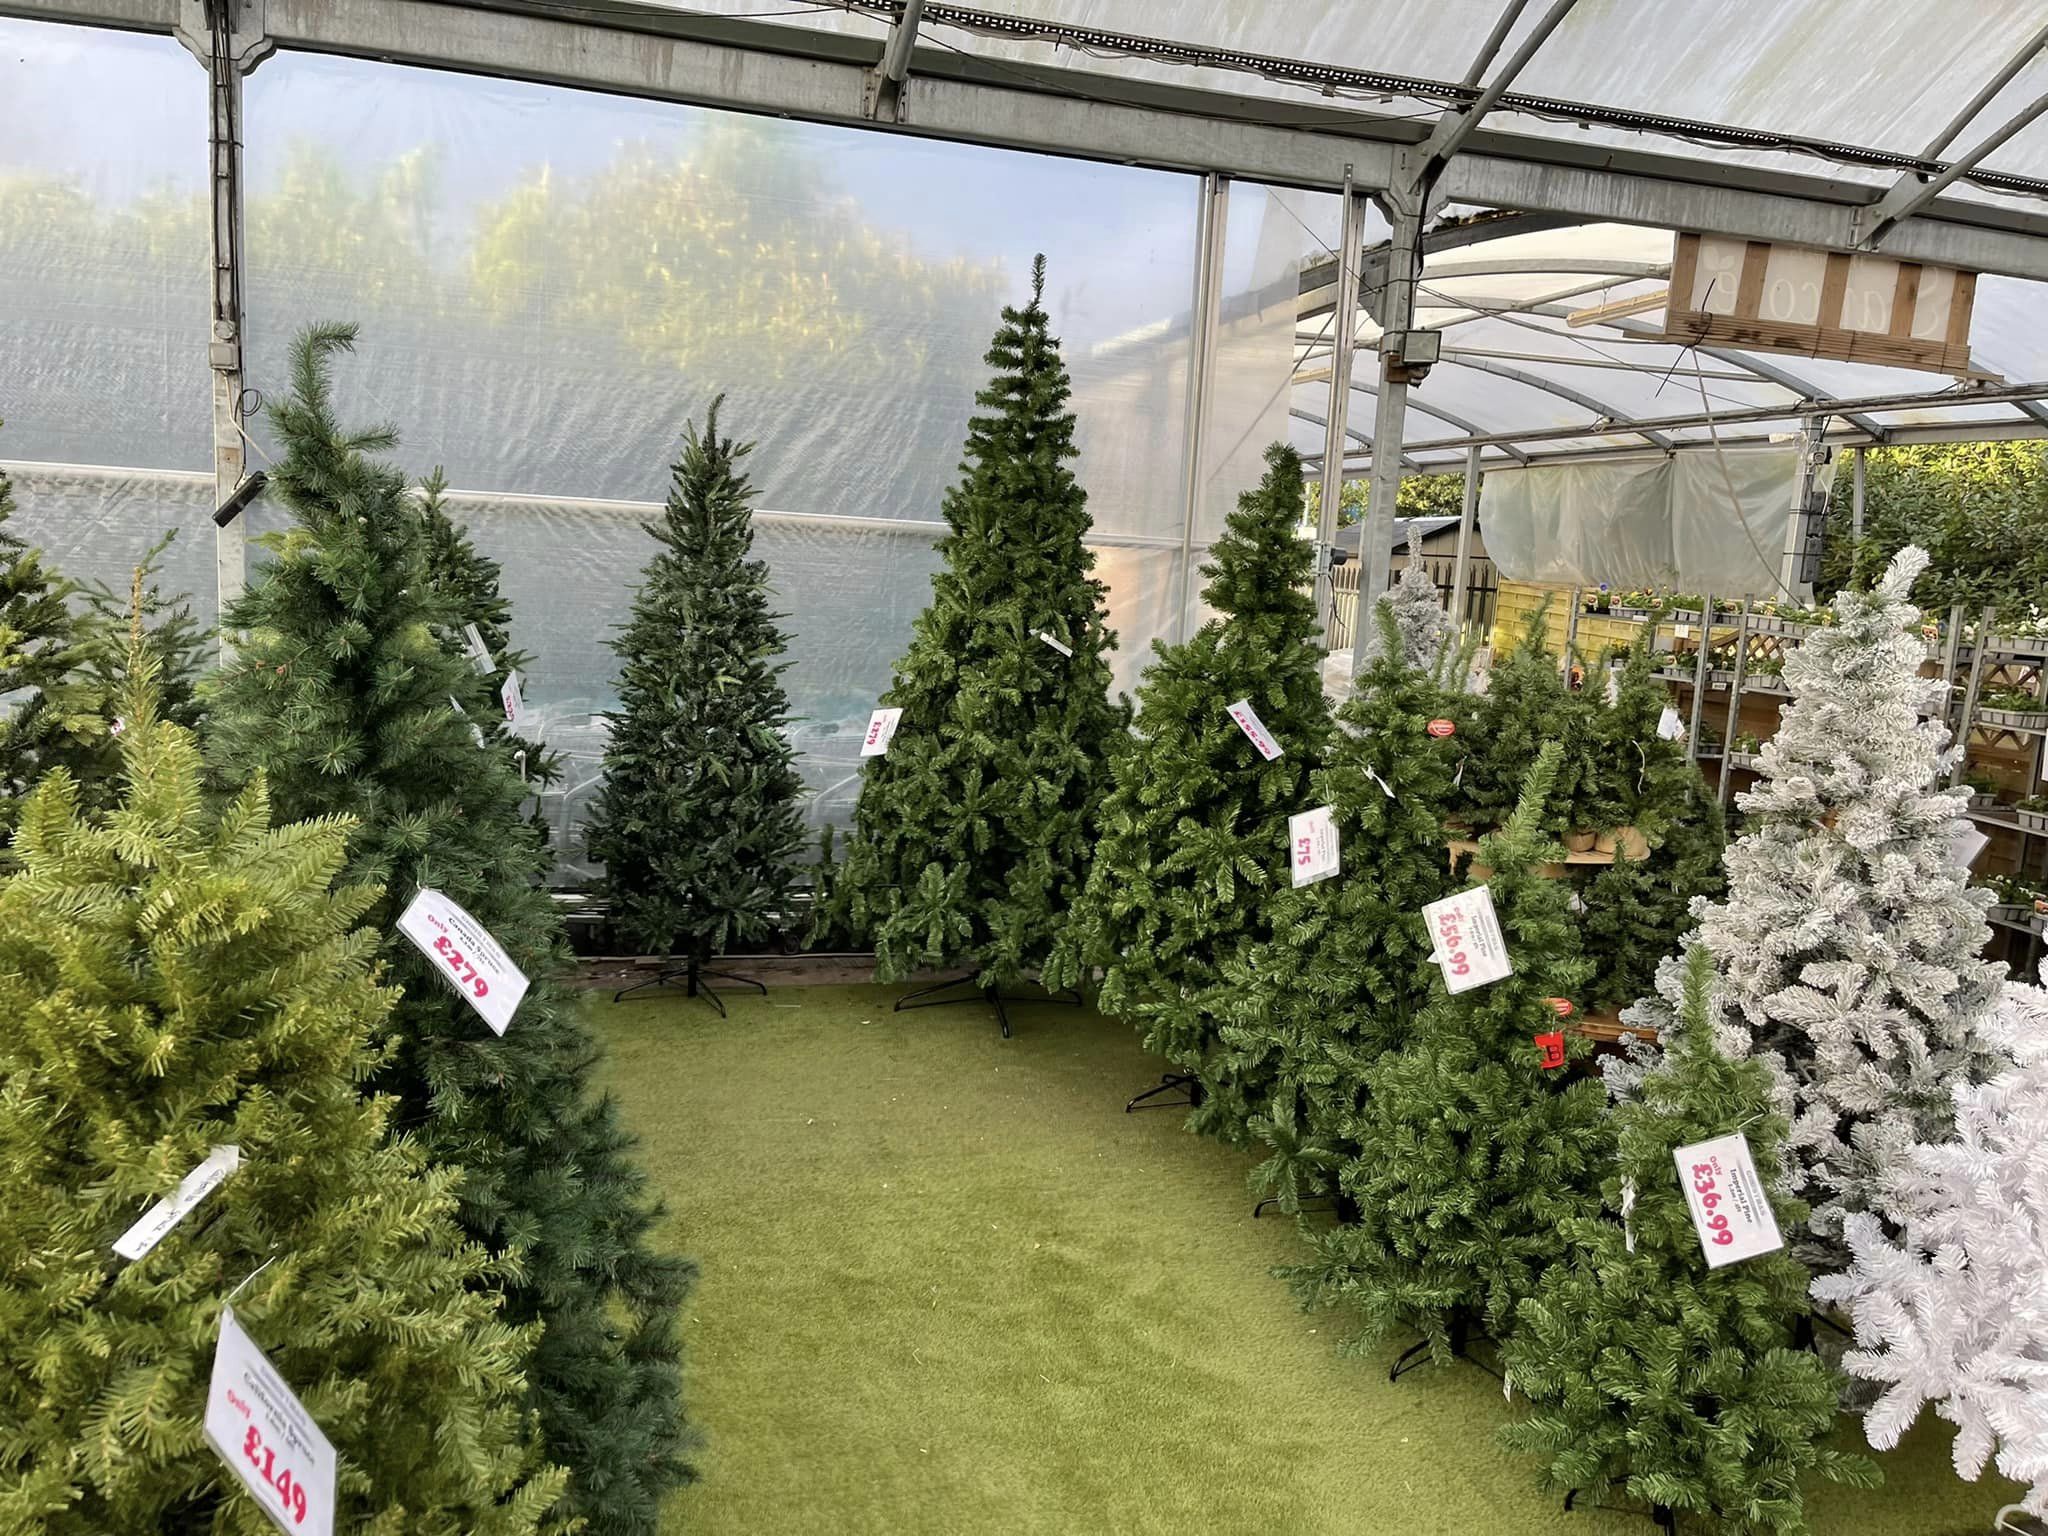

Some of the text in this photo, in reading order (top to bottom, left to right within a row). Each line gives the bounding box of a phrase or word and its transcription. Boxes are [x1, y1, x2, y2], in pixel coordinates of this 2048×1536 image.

[1298, 837, 1311, 865] £75
[427, 914, 449, 934] Only
[448, 917, 476, 947] Canada
[477, 945, 500, 974] Spruce
[1439, 913, 1470, 975] £56.99
[433, 935, 489, 998] £279
[1710, 1155, 1723, 1176] Only
[1692, 1163, 1734, 1246] £36.99
[1730, 1168, 1752, 1223] Imperial Pine
[243, 1425, 307, 1525] £149
